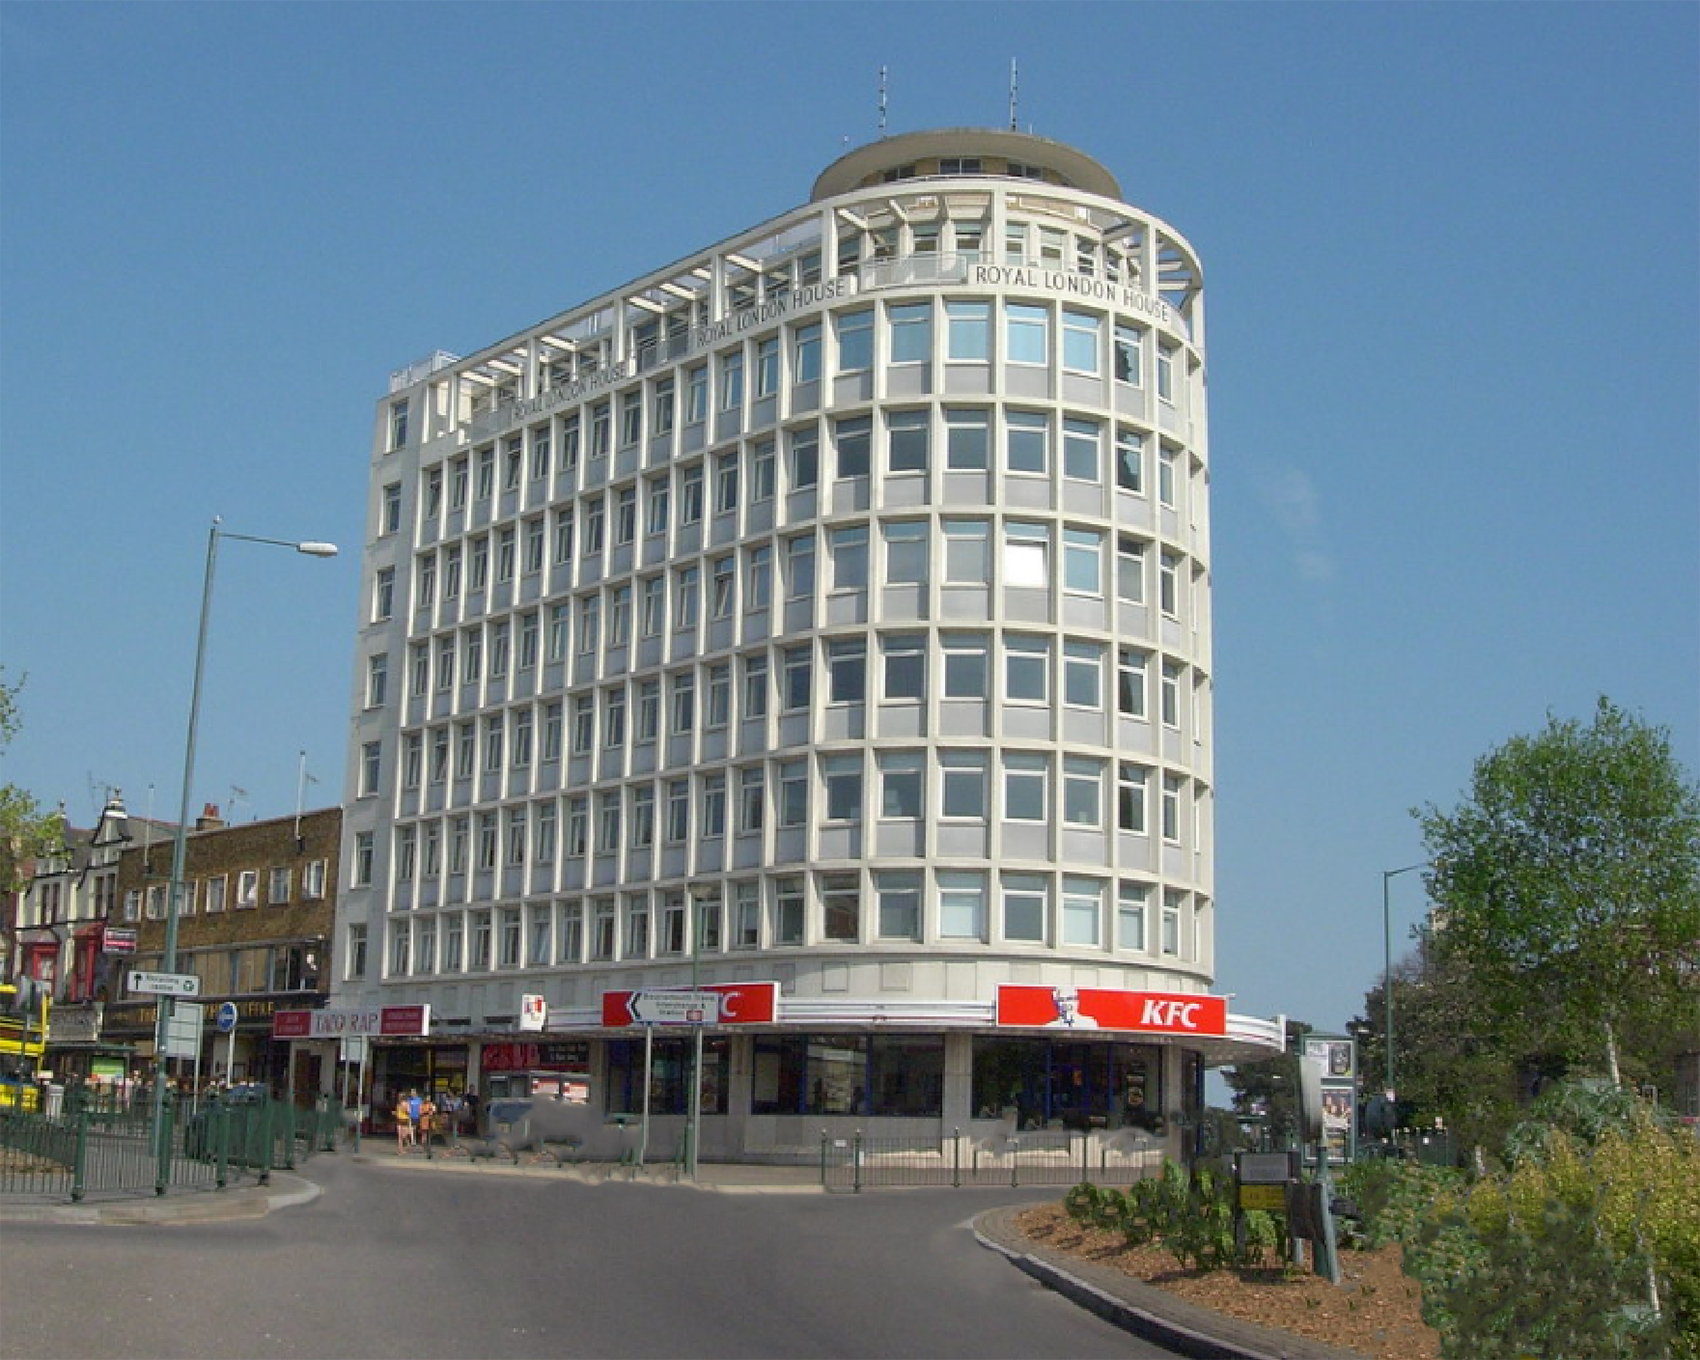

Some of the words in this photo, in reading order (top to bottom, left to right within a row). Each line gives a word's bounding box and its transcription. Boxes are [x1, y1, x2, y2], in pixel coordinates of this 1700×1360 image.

[698, 319, 732, 347] ROYAL
[737, 299, 786, 333] LONDON
[793, 279, 845, 310] HOUSE
[976, 266, 1037, 287] ROYAL
[1044, 267, 1116, 302] LONDON
[1123, 288, 1169, 322] HOUSE
[1140, 999, 1203, 1028] KFC
